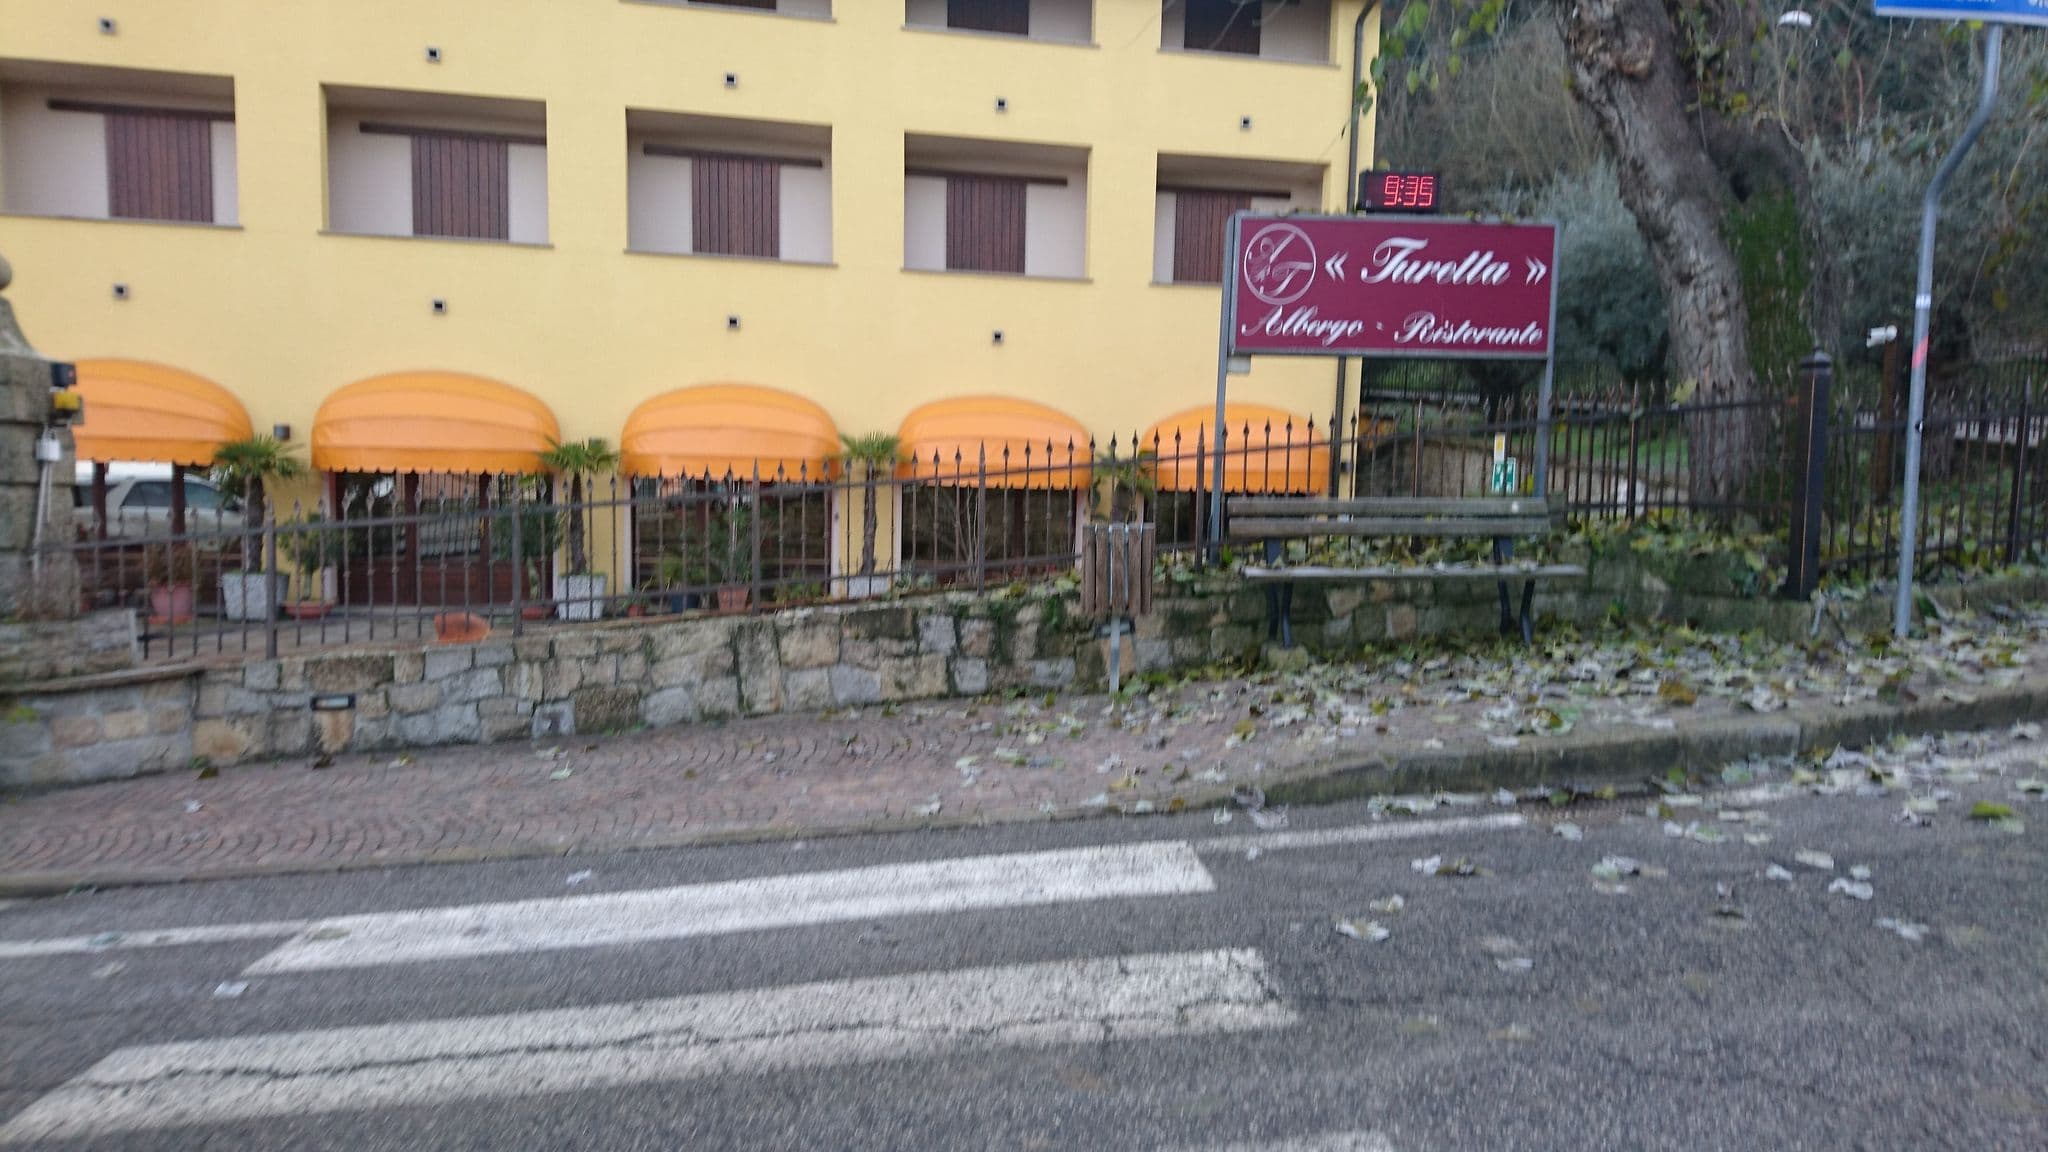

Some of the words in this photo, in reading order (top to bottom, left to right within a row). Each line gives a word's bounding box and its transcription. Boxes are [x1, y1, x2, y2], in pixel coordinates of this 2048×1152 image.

[1384, 175, 1434, 206] 9:35
[1360, 237, 1511, 285] Turetta
[1241, 305, 1364, 346] Albergo
[1393, 310, 1543, 345] Ristorante
